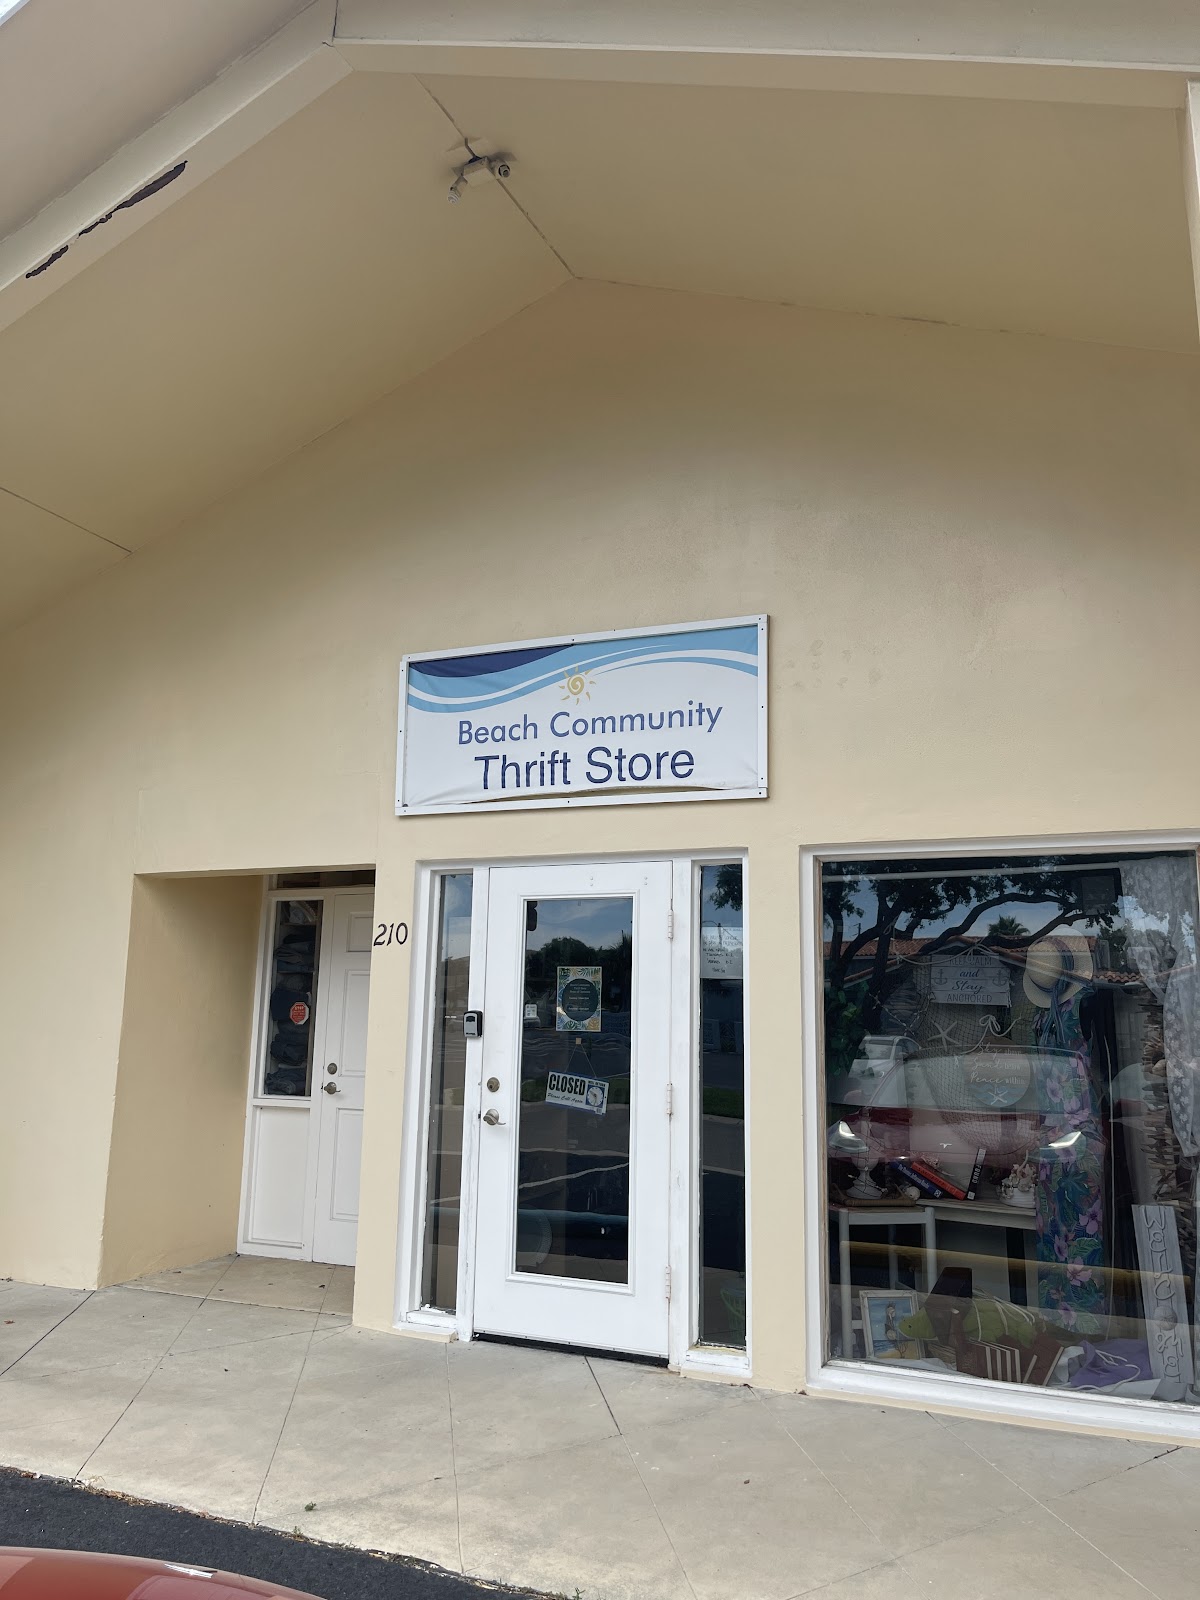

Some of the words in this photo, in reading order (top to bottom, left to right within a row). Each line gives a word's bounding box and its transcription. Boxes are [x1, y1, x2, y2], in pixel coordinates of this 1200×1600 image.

[458, 713, 538, 745] Beach
[550, 700, 723, 738] Community
[474, 749, 571, 790] Thrift
[585, 746, 695, 784] Store
[373, 922, 409, 947] 210
[960, 968, 980, 978] and
[952, 980, 985, 994] Stay
[946, 994, 992, 1004] ANCHORED
[548, 1074, 586, 1096] CLOSED
[970, 1071, 1004, 1083] Peace
